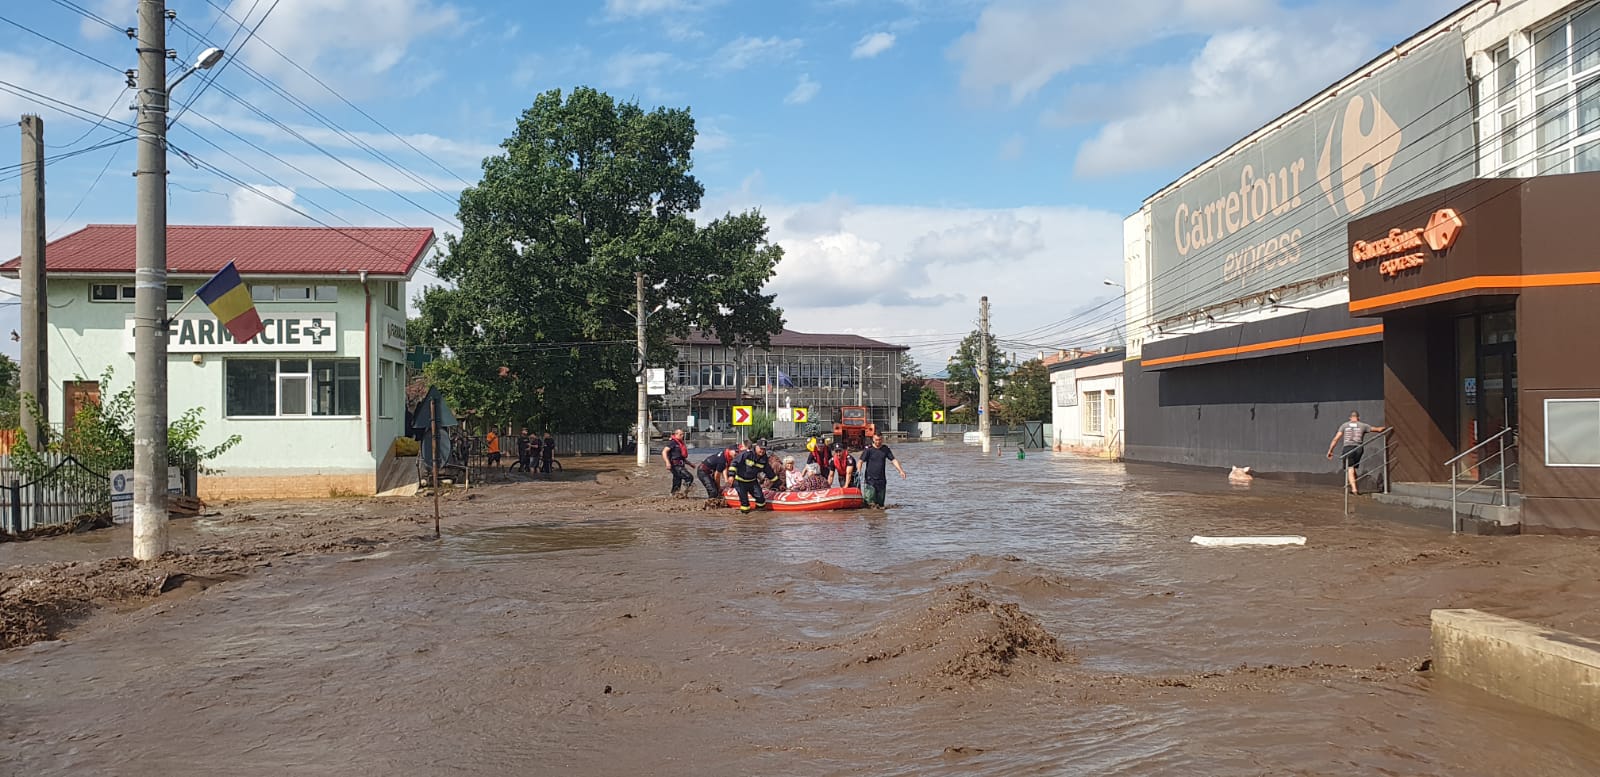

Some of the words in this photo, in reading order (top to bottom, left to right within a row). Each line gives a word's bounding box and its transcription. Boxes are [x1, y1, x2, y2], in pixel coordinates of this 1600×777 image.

[1175, 158, 1305, 256] Carrefour
[1223, 228, 1302, 289] express
[1353, 228, 1425, 263] Carrefour
[1379, 253, 1425, 277] express
[167, 319, 301, 345] FARMCIE
